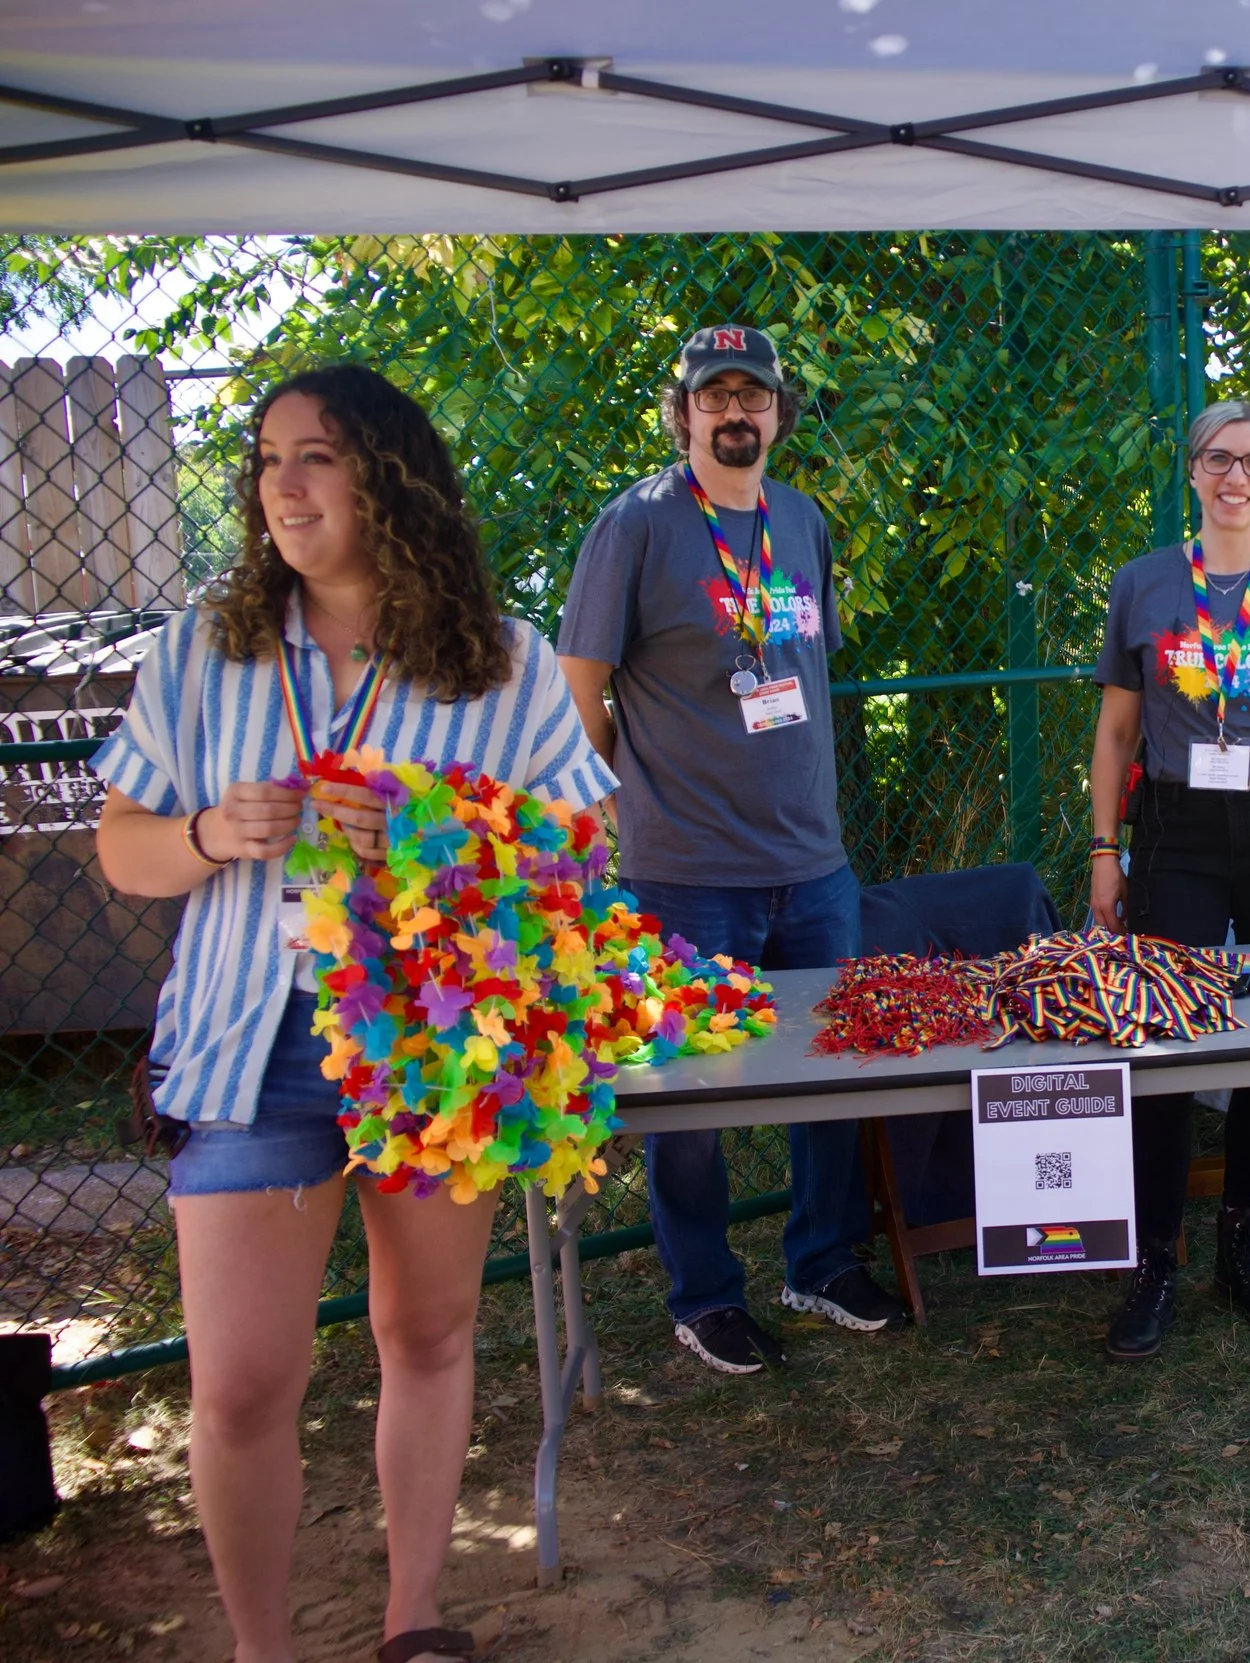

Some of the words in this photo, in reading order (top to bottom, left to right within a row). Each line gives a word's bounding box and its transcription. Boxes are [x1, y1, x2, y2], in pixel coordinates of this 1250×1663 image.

[713, 328, 747, 351] N
[769, 595, 811, 612] OLORS
[768, 617, 790, 633] 24
[1011, 1073, 1089, 1093] DIGITAL
[986, 1099, 1050, 1119] EVENT
[1055, 1096, 1116, 1115] GUIDE
